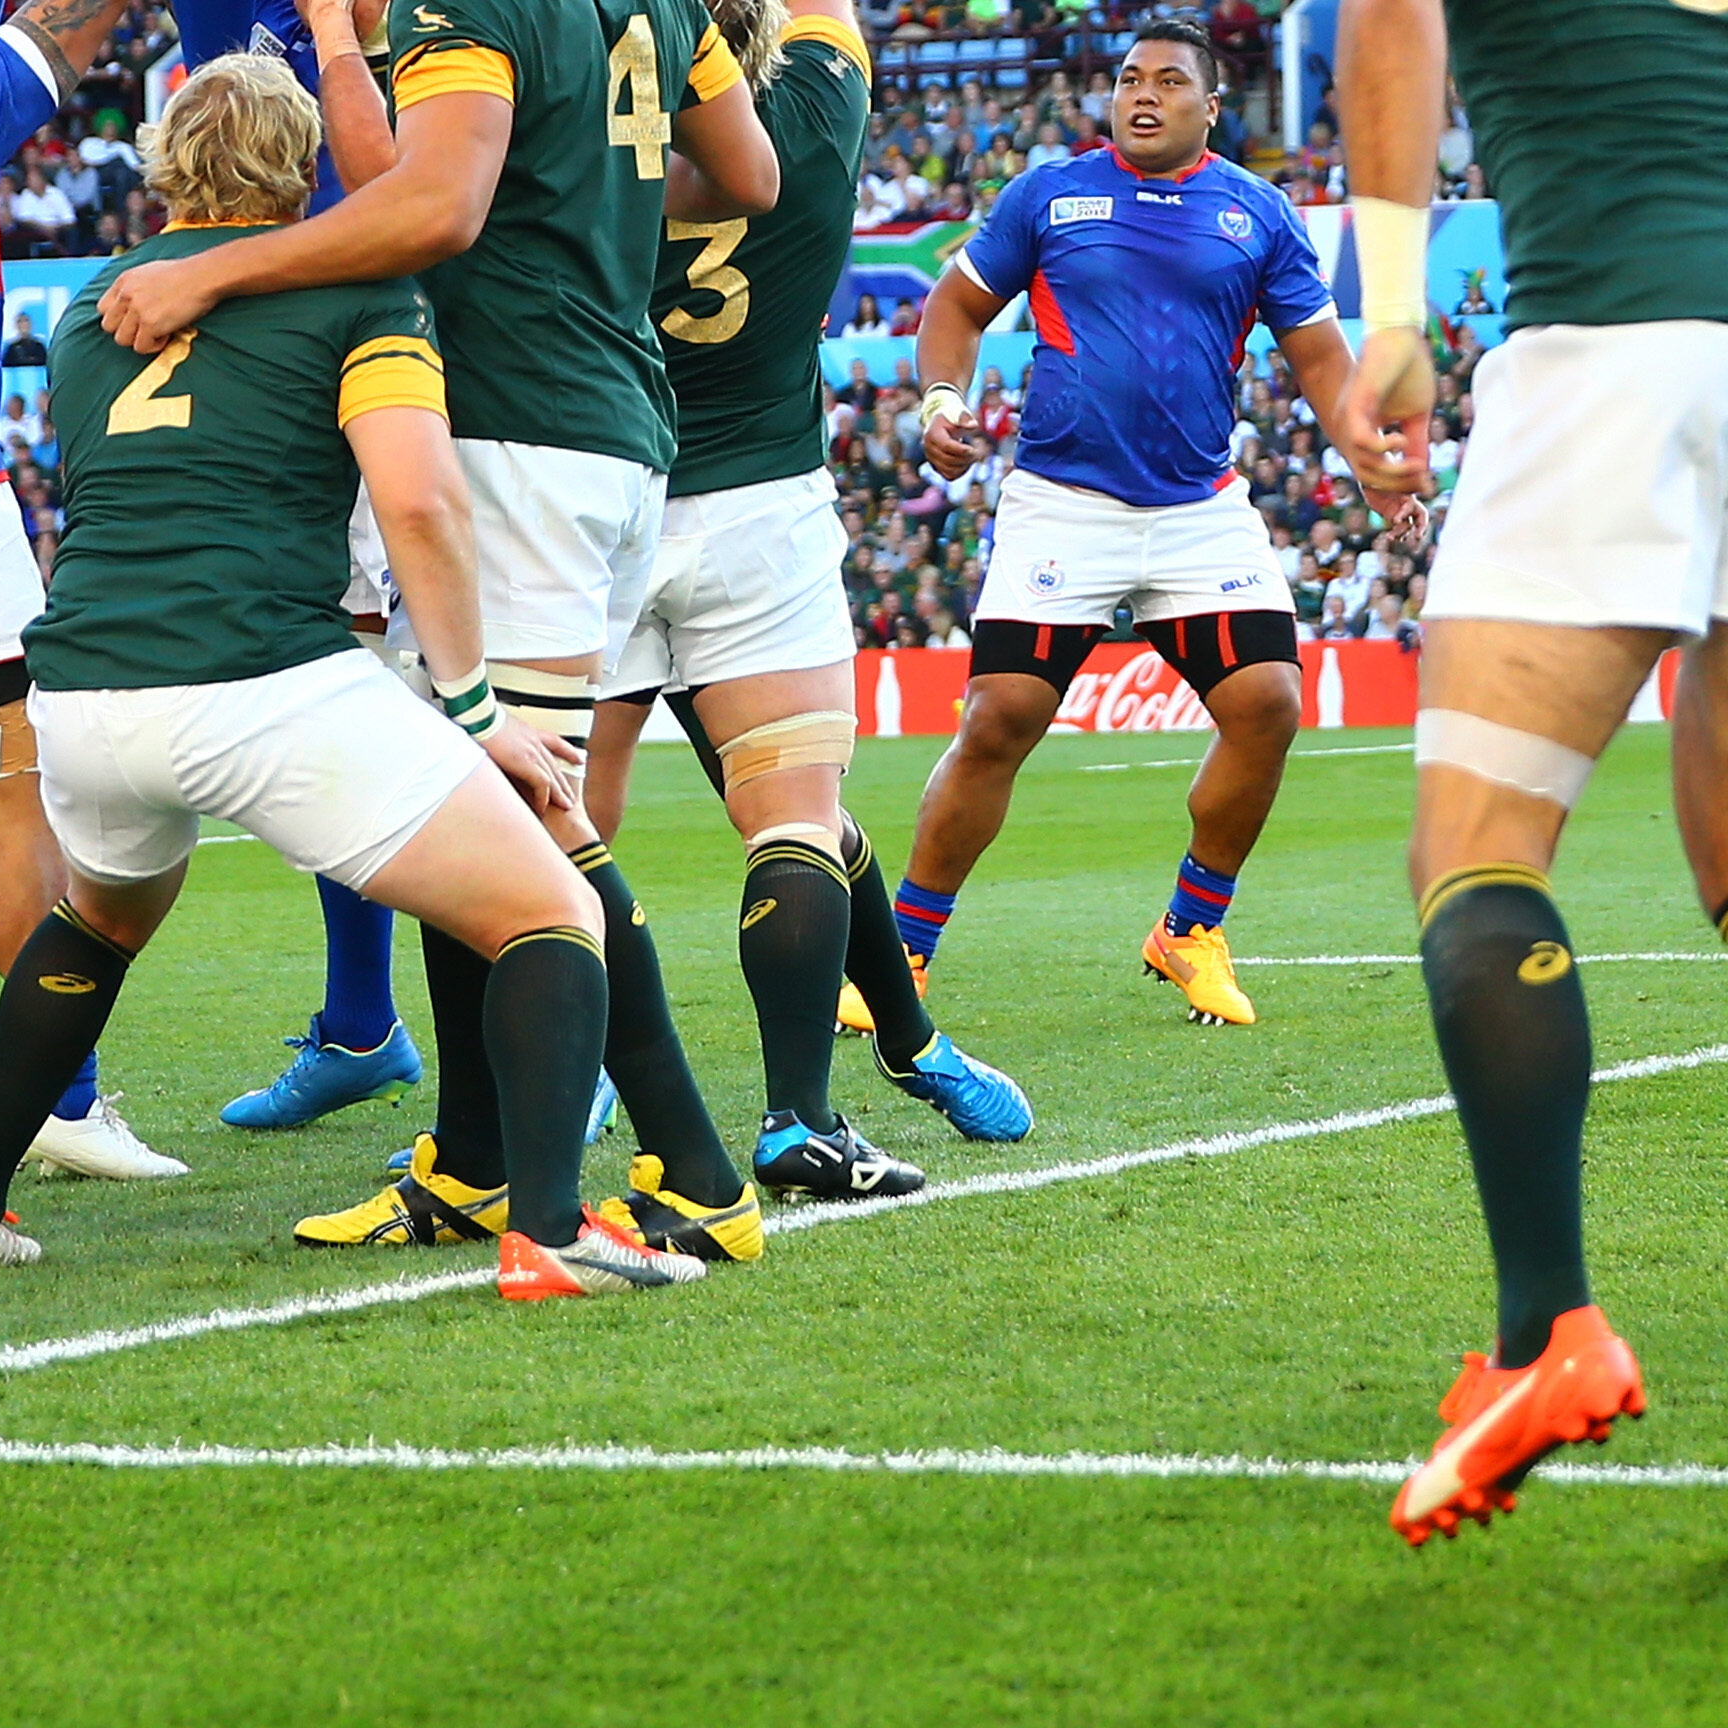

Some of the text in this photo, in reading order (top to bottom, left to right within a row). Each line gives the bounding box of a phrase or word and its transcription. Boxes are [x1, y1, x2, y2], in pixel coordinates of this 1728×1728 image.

[607, 13, 673, 179] 4
[1136, 190, 1184, 206] BLK
[659, 217, 751, 345] 3
[105, 328, 198, 437] 2
[1220, 572, 1263, 593] BLK
